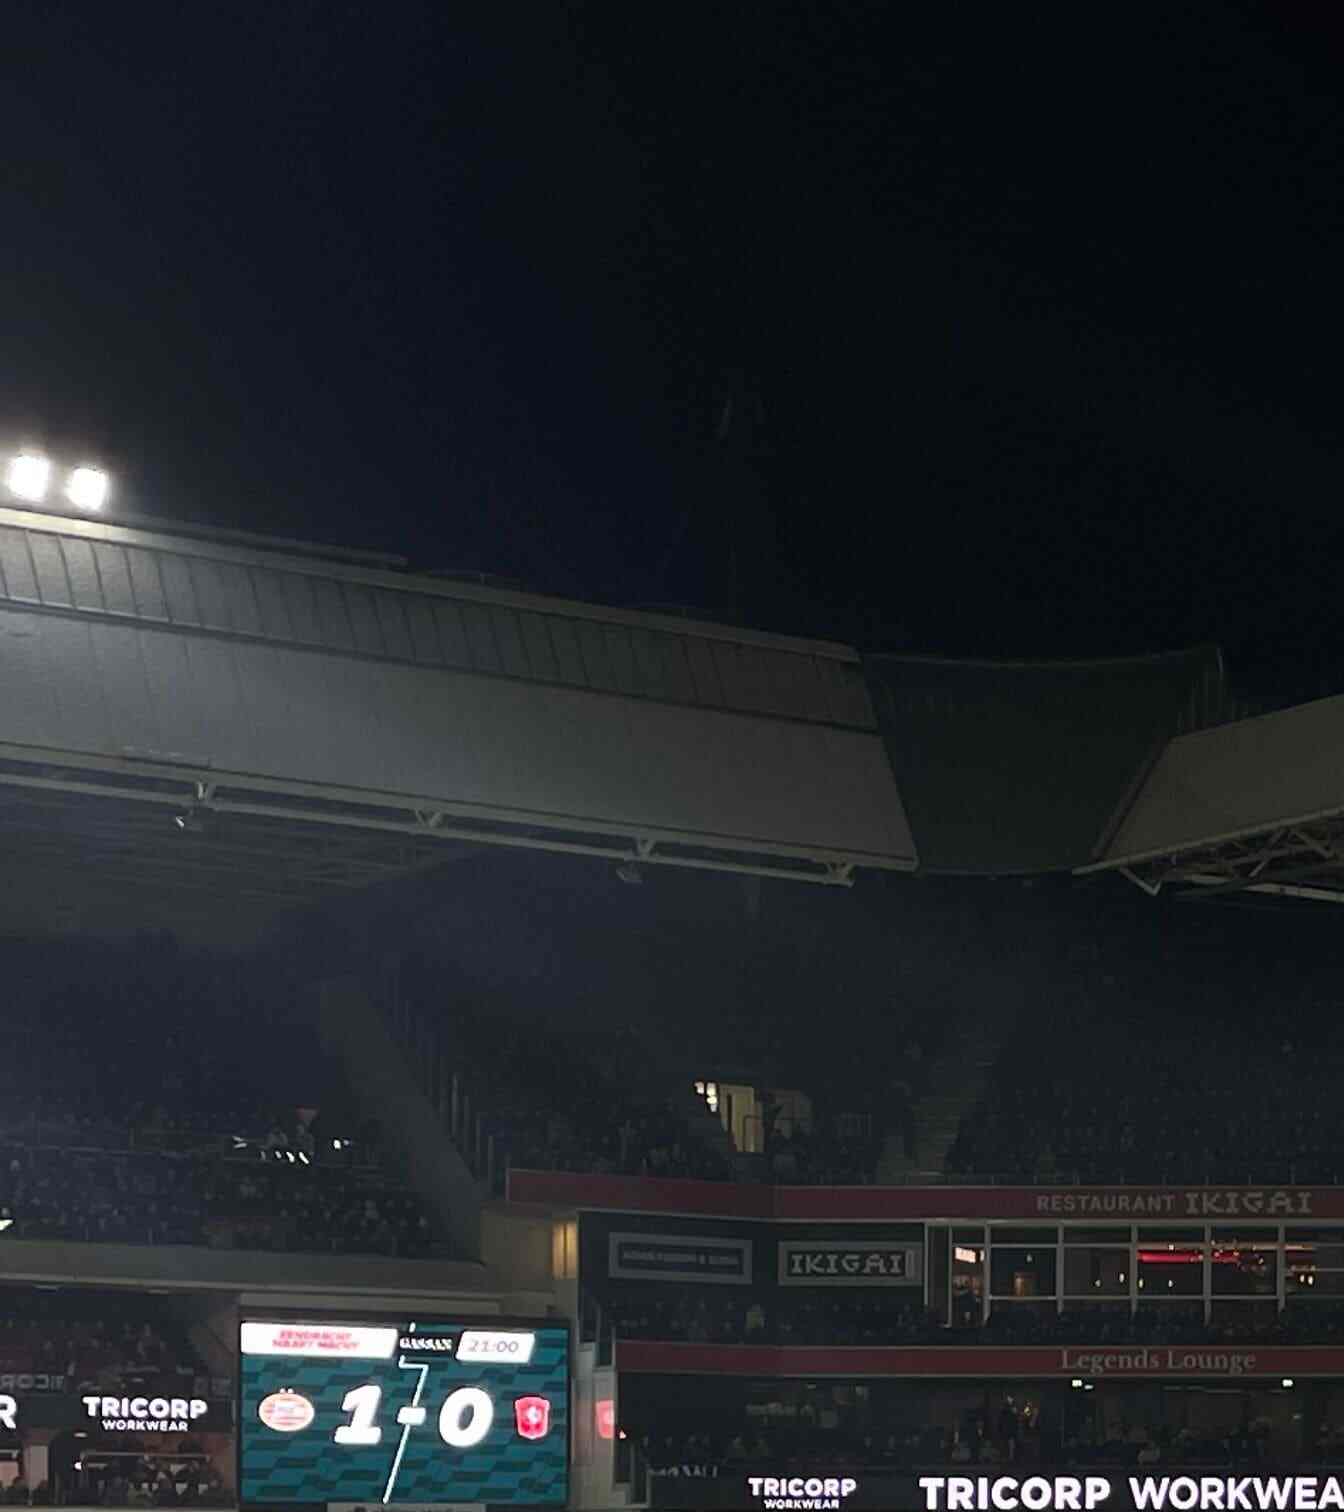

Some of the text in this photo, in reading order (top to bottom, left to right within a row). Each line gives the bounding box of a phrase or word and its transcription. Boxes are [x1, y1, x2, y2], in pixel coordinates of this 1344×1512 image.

[1037, 1191, 1312, 1214] RESTAURANT IKIGAI
[790, 1253, 903, 1274] IKIGAI
[468, 1339, 519, 1354] 21:00
[1061, 1350, 1256, 1373] Legends Lounge
[82, 1396, 208, 1419] TRICORP
[101, 1419, 189, 1432] WORKWEAR
[747, 1477, 857, 1498] TRICORP
[918, 1476, 1111, 1510] TRICORP
[763, 1498, 840, 1510] WORKWEAR
